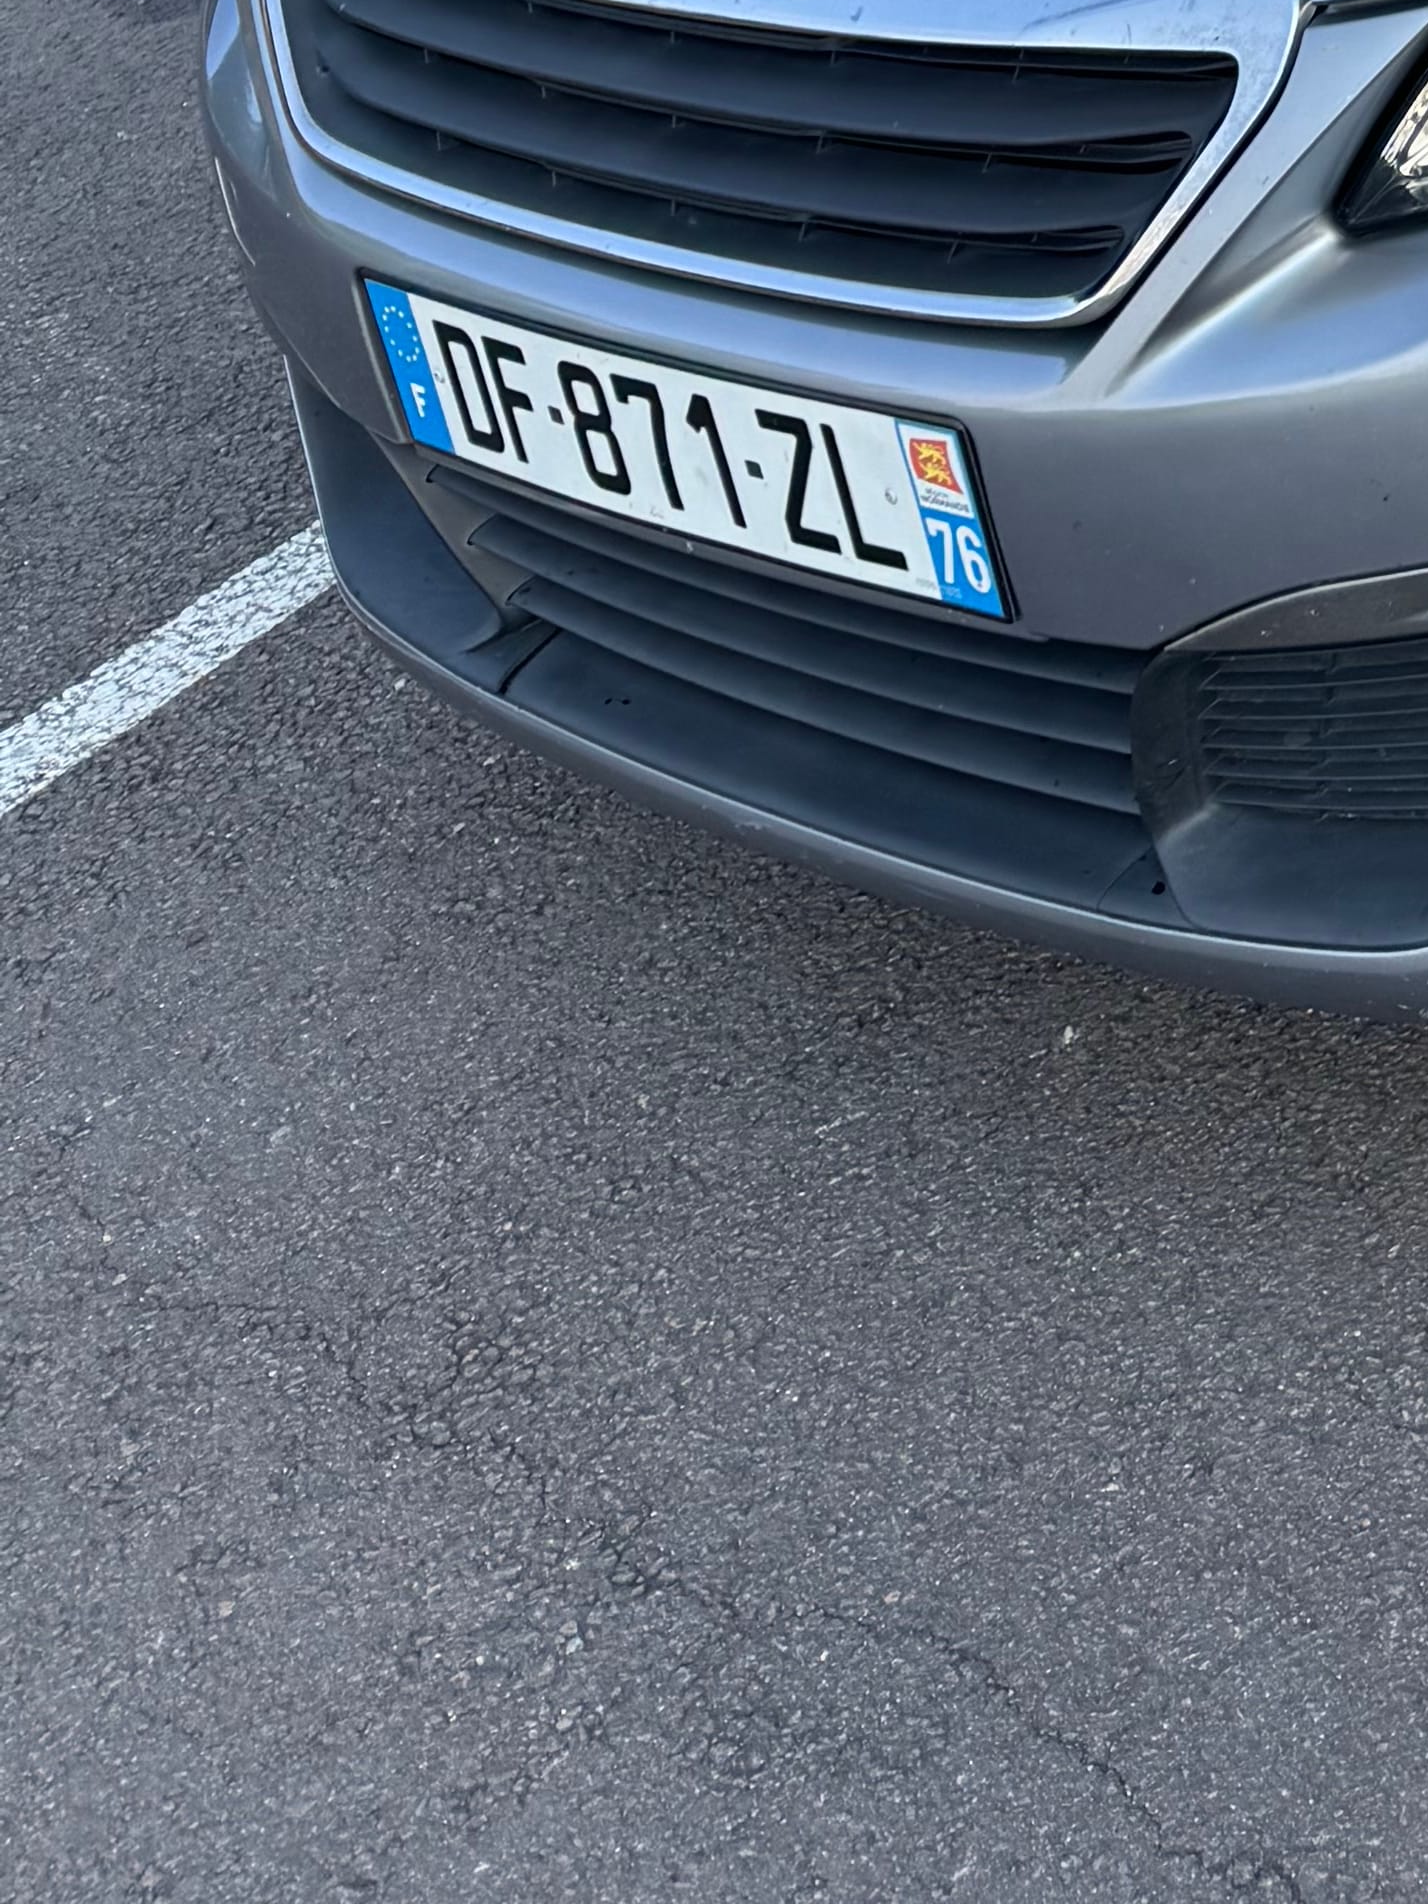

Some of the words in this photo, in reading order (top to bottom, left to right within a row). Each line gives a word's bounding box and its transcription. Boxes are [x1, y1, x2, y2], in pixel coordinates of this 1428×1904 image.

[410, 383, 427, 418] F
[433, 319, 909, 571] DF-871-ZL
[925, 517, 992, 594] 76
